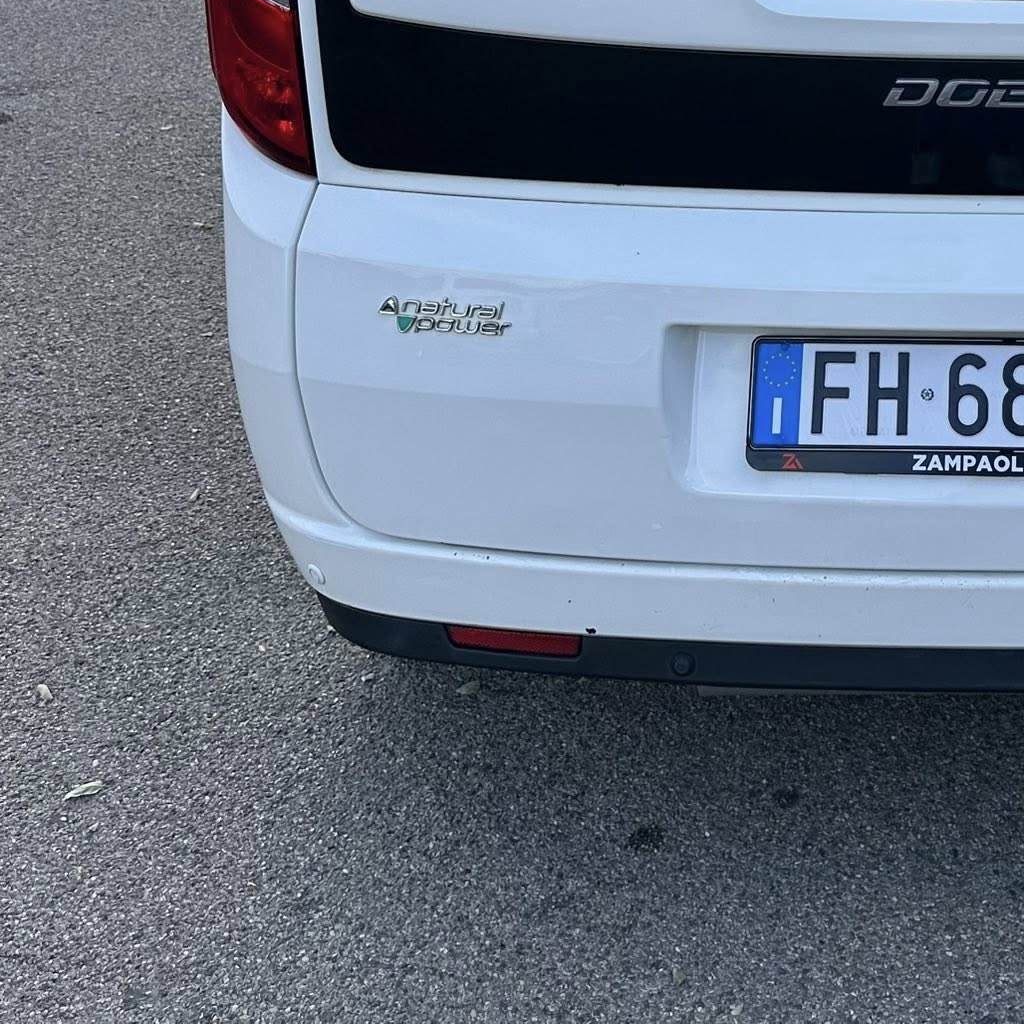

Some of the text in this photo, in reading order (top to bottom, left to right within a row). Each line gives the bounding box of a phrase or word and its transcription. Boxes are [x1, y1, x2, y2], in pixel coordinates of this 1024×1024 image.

[403, 297, 505, 320] natural
[414, 316, 512, 336] power
[811, 351, 911, 436] FH
